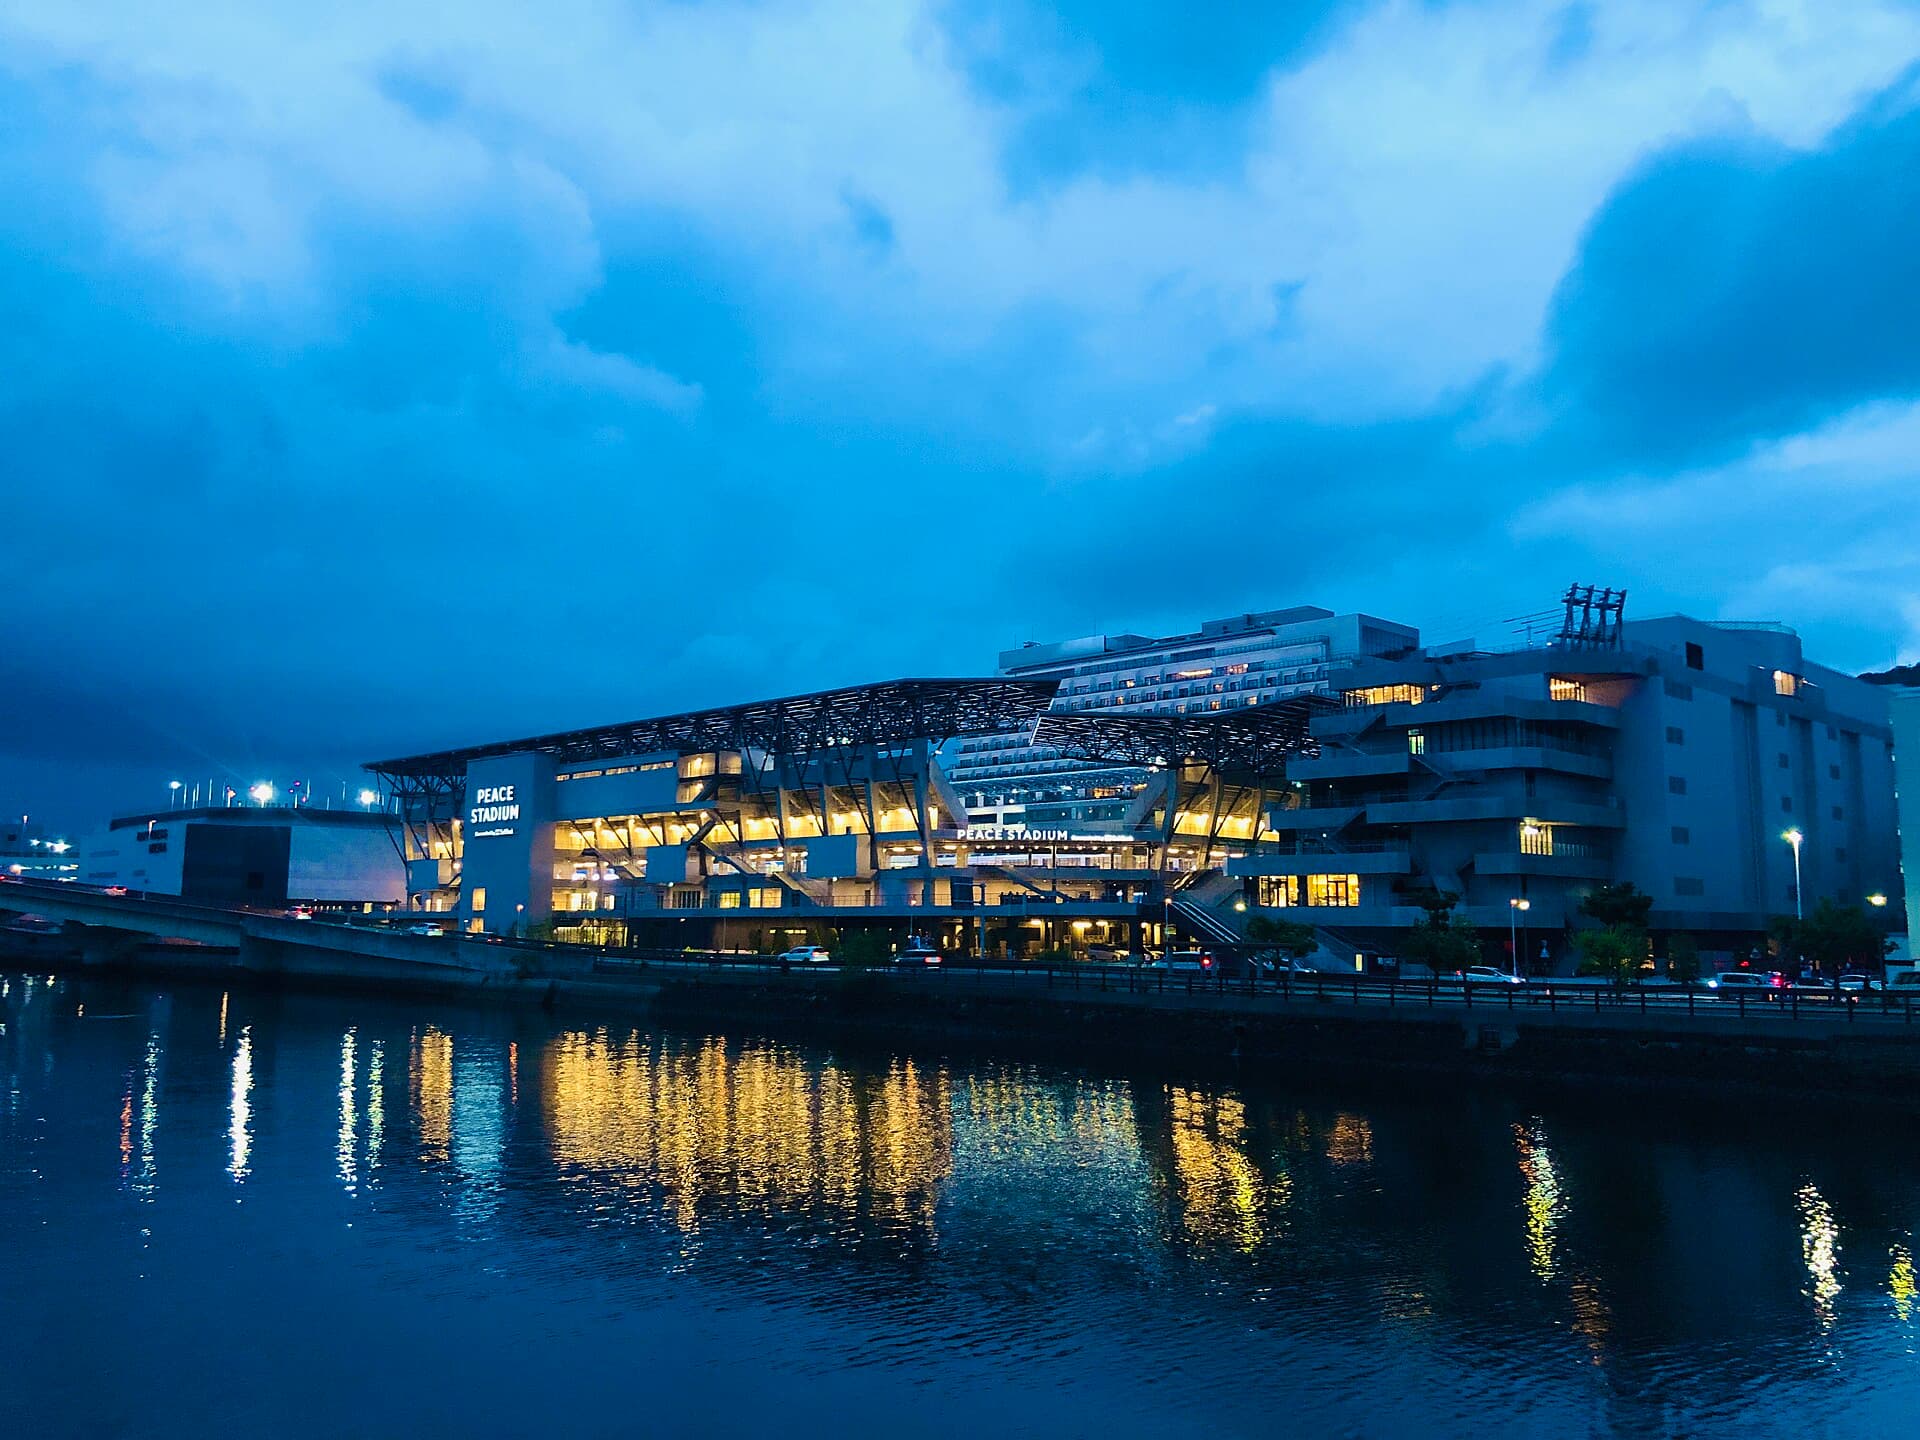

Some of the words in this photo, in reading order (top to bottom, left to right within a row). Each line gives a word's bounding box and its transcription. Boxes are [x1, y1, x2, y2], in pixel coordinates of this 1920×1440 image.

[477, 785, 514, 803] PEACE
[470, 804, 519, 823] STADIUM
[957, 829, 1003, 841] PEACE
[1007, 829, 1068, 841] STADIUM
